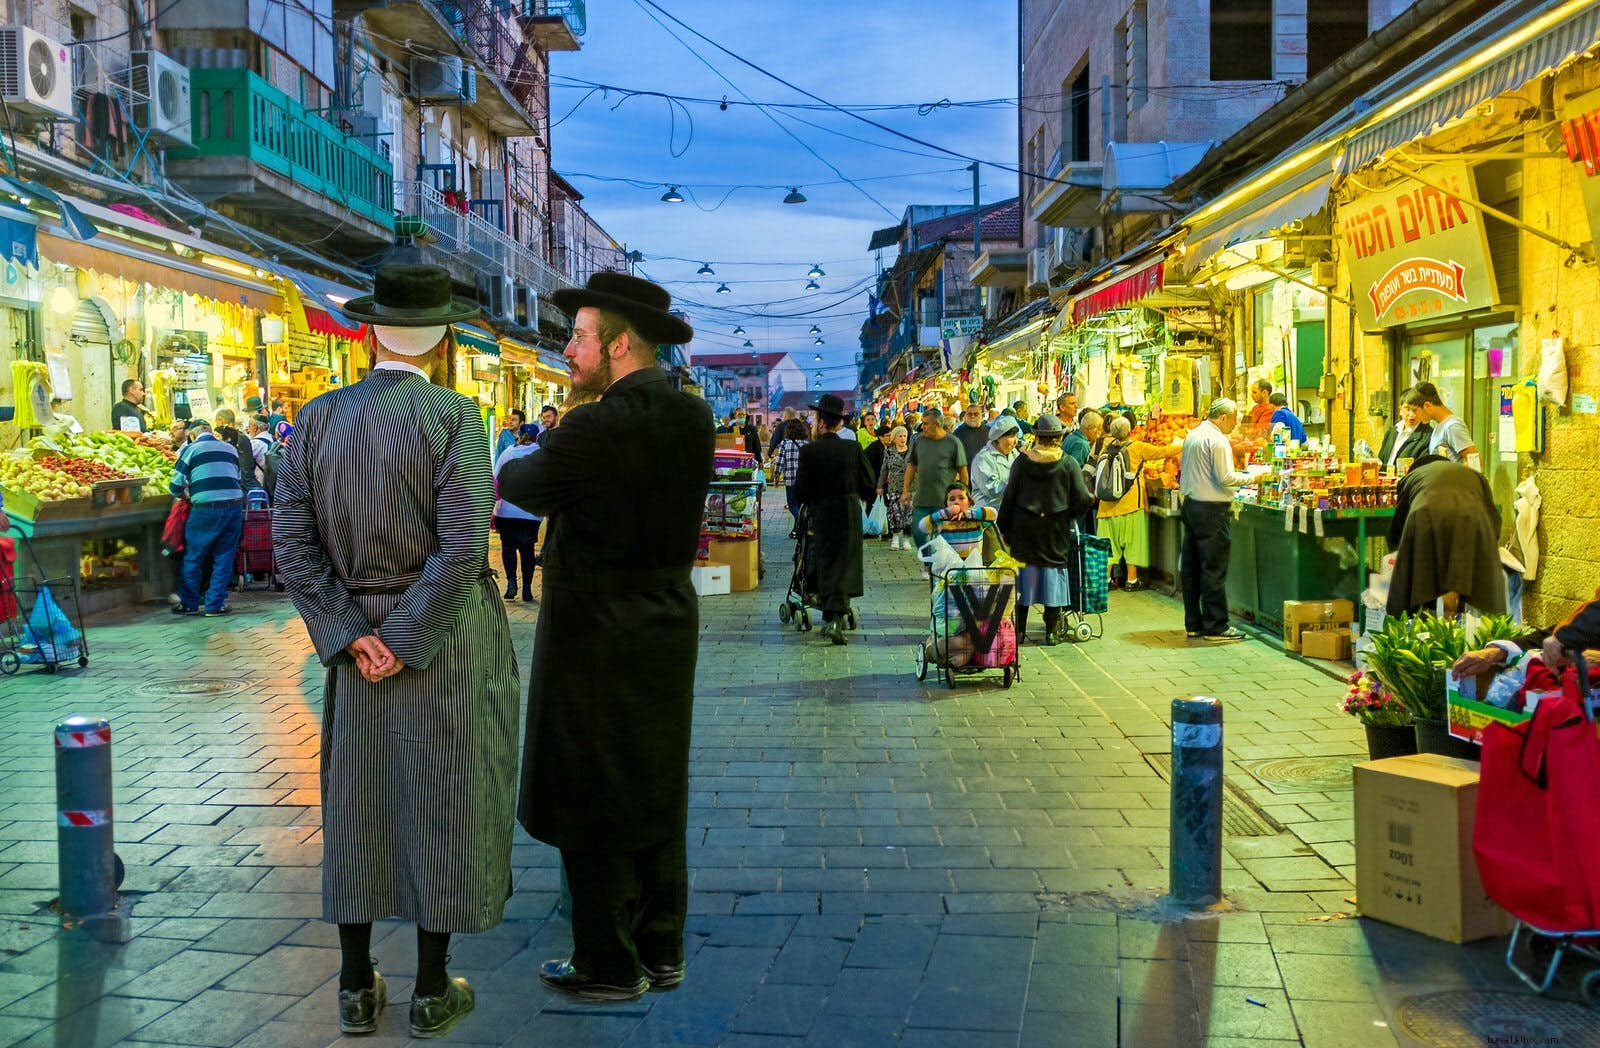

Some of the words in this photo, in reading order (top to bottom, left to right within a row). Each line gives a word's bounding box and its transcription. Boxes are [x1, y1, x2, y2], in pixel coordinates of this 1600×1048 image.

[1396, 175, 1468, 243] אחים
[1400, 267, 1418, 285] בשר
[1388, 849, 1414, 867] 10oz
